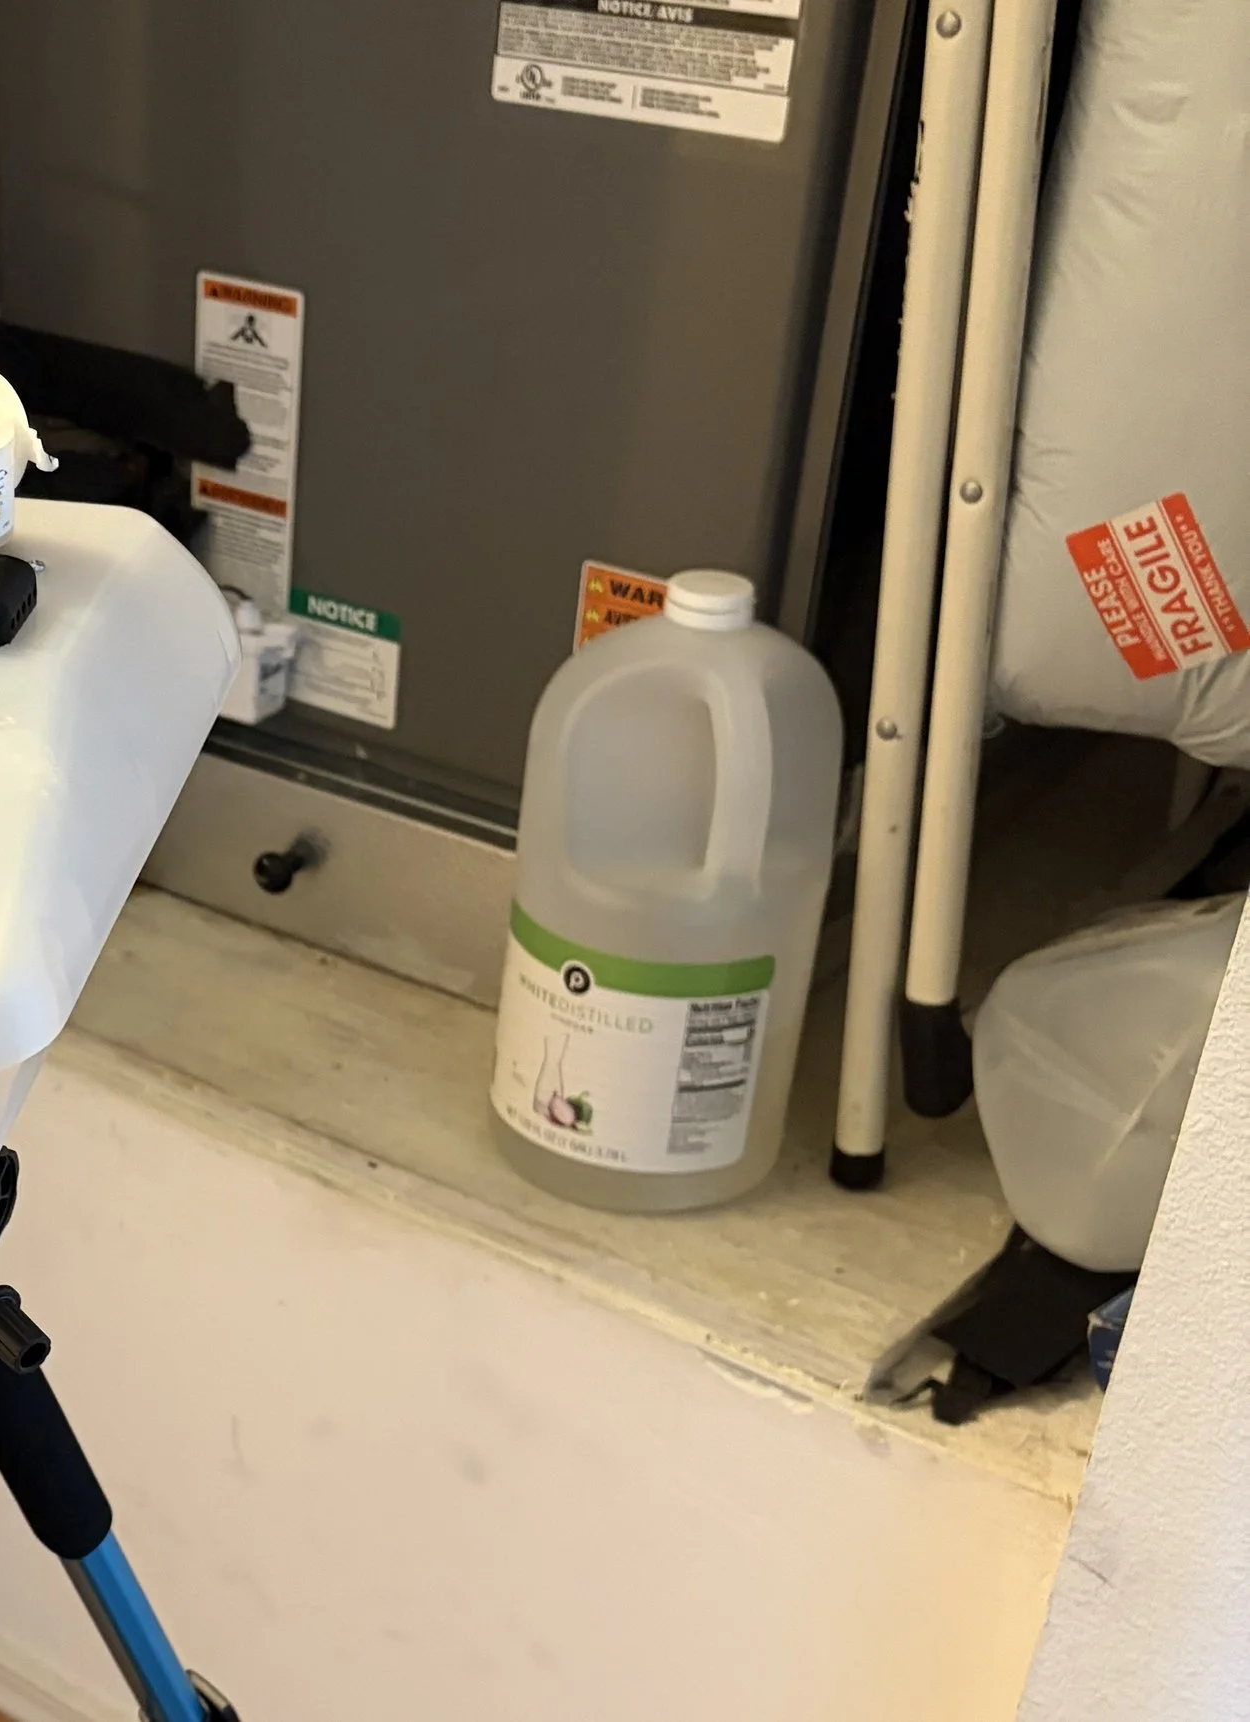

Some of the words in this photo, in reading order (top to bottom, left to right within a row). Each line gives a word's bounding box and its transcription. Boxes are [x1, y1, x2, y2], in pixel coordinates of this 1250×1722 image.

[1097, 537, 1124, 577] CARE
[1123, 516, 1213, 657] FRAGILE
[308, 596, 377, 632] NOTICE
[1083, 566, 1141, 648] PLEASE
